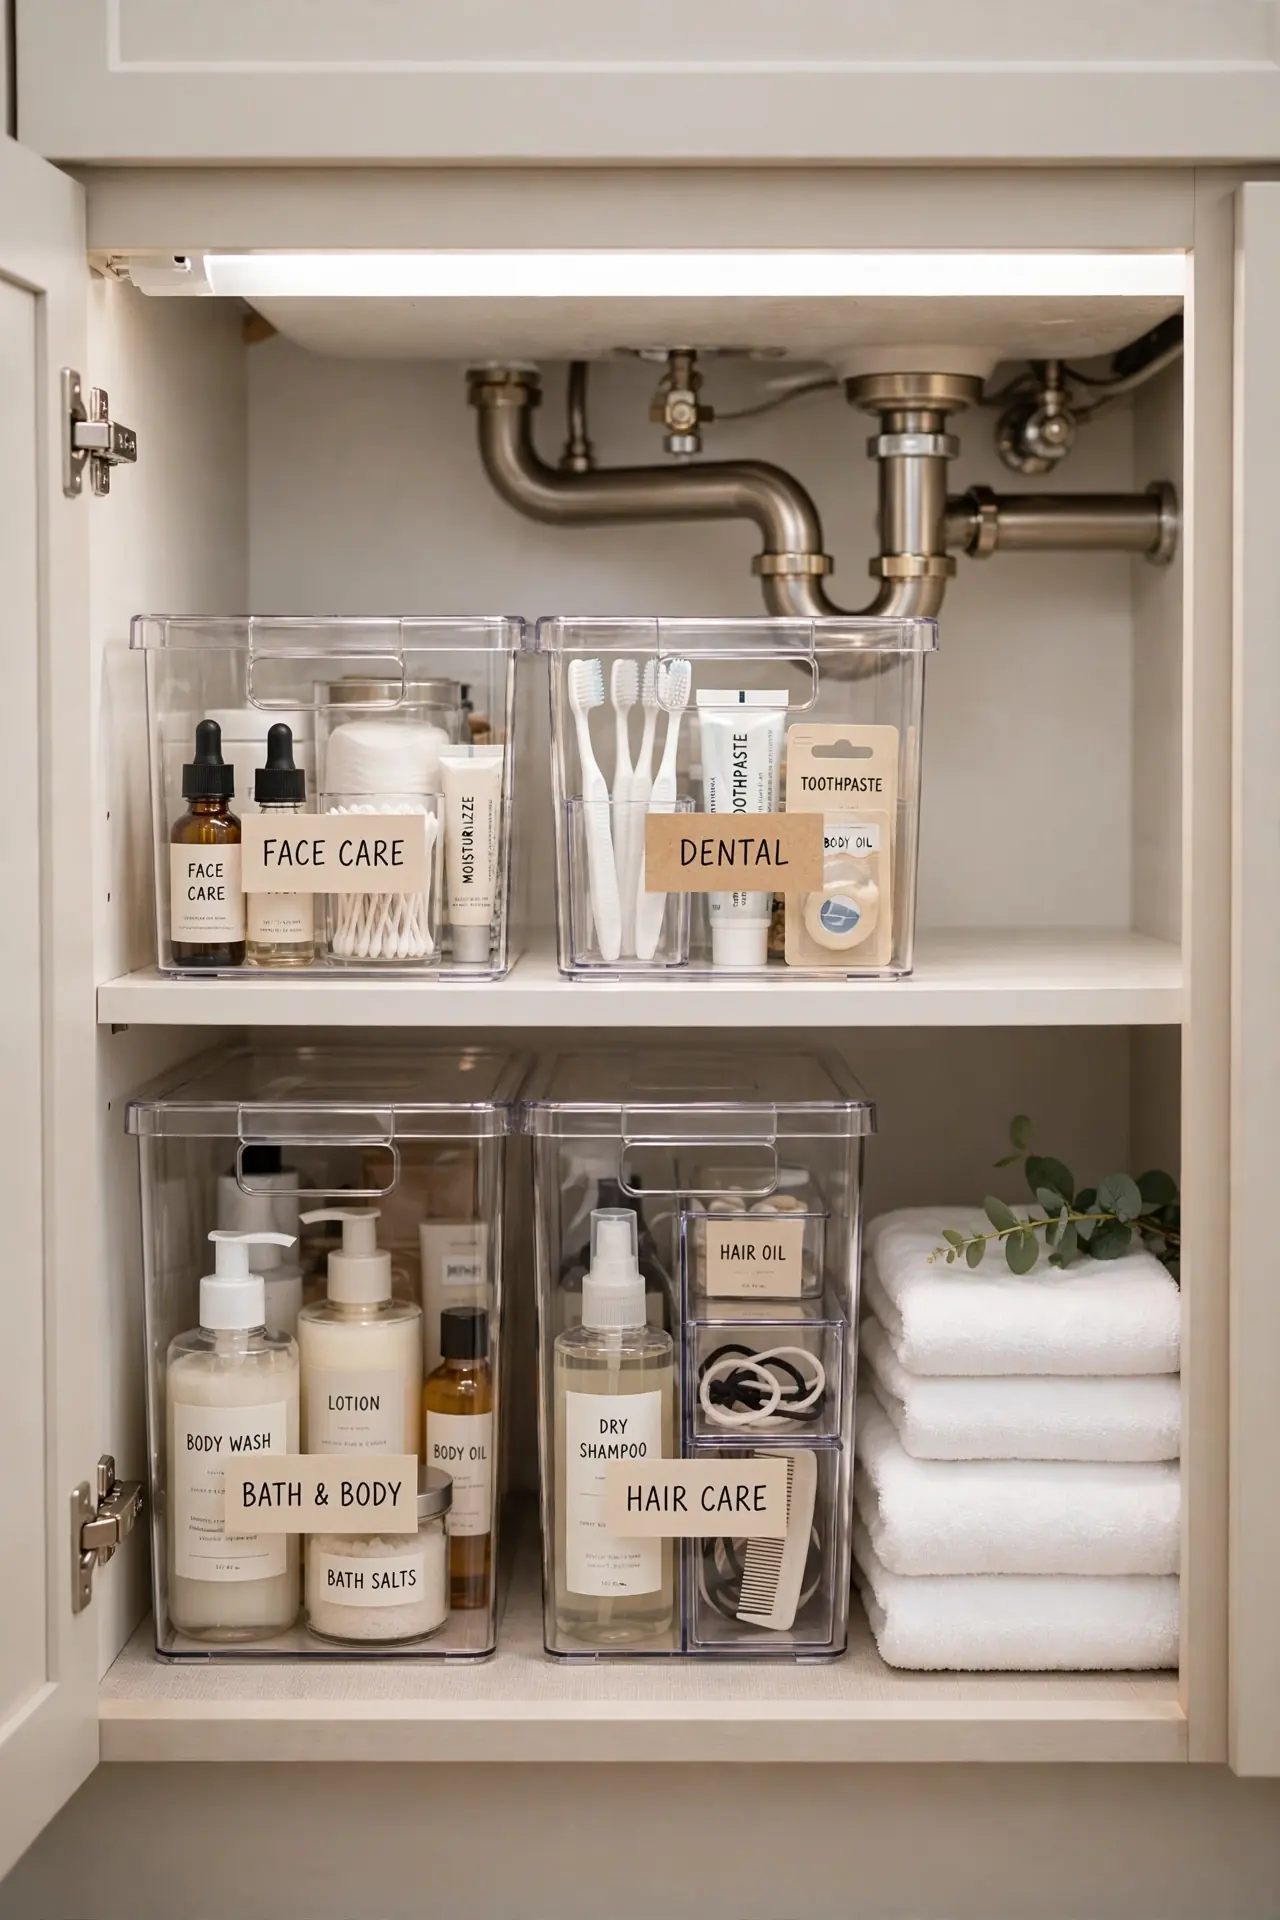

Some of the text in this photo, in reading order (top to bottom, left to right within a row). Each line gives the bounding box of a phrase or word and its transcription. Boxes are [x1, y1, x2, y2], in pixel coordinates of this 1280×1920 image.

[732, 733, 748, 813] OTHPASTE
[800, 776, 883, 793] TOOTHPASTE
[824, 836, 873, 849] BODY OIL
[263, 838, 405, 867] FACE CARE
[680, 838, 789, 867] DENTAL
[188, 862, 224, 878] FACE
[187, 885, 225, 901] CARE
[720, 1243, 786, 1261] HAIR OIL
[328, 1395, 380, 1412] LOTION
[599, 1418, 628, 1435] DRY
[186, 1432, 271, 1453] BODY WASH
[579, 1442, 647, 1460] SHAMPOO
[433, 1443, 487, 1461] BODY OIL
[242, 1481, 402, 1508] BATH & BODY
[627, 1484, 767, 1512] HAIR CARE
[327, 1568, 417, 1590] BATH SALTS
